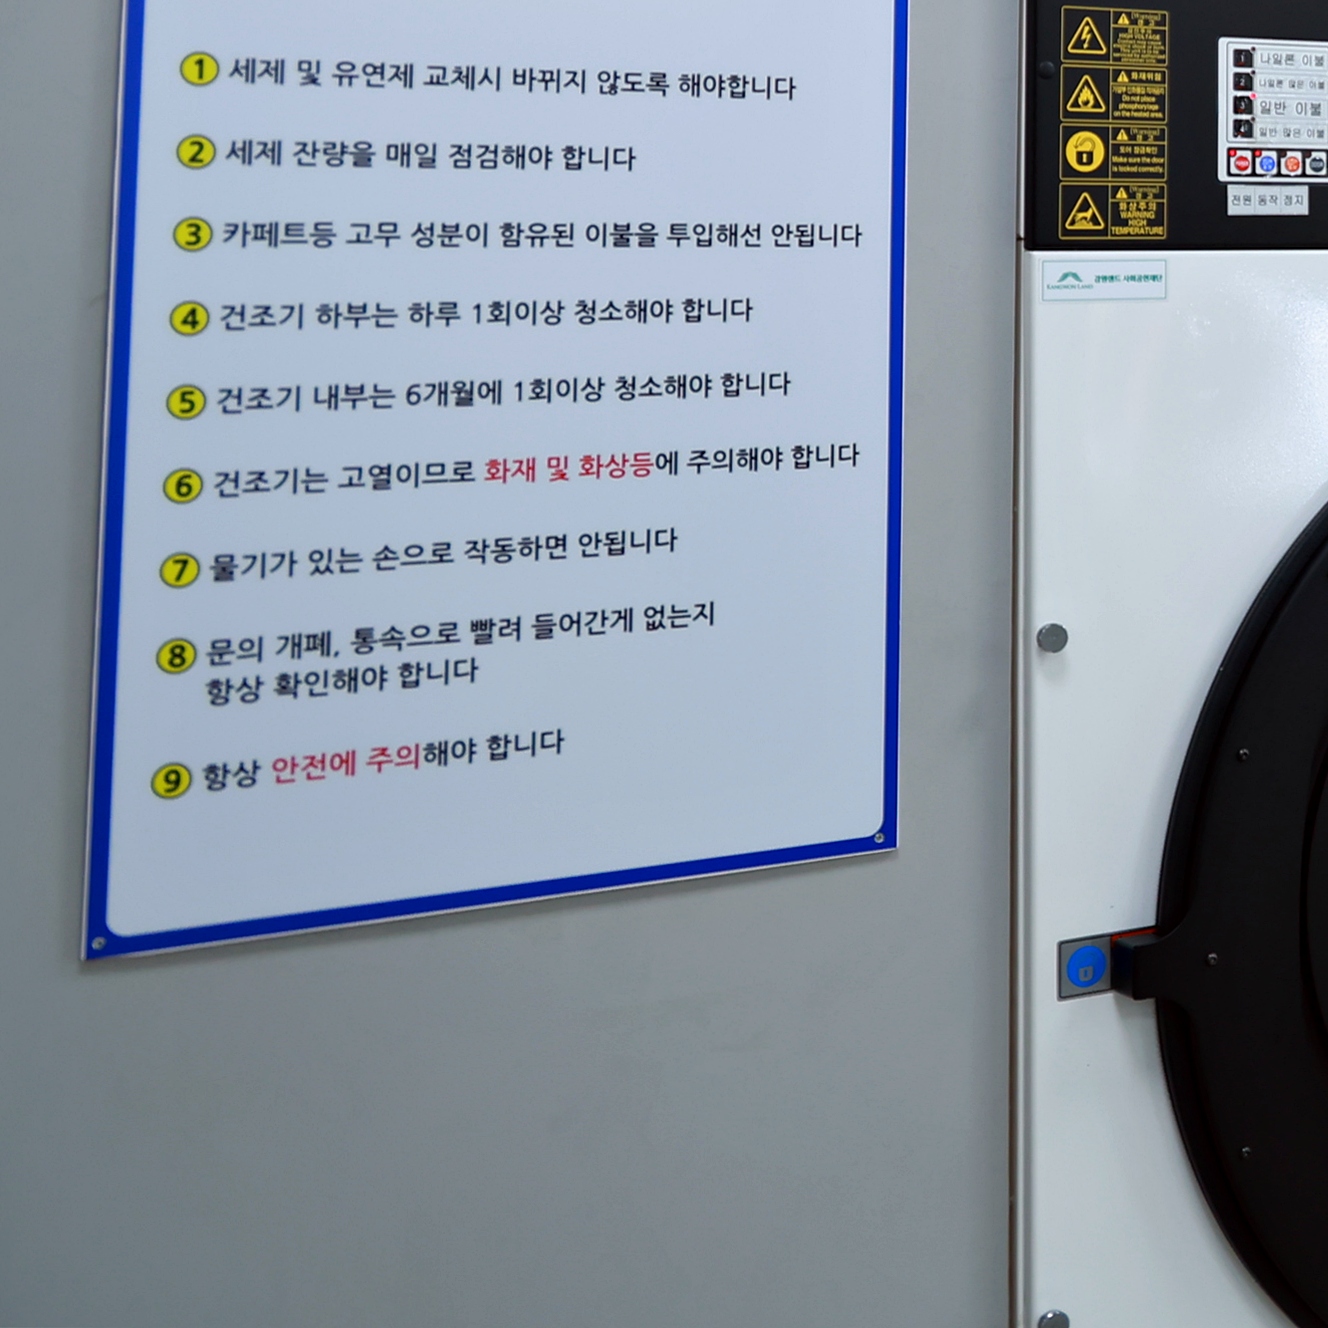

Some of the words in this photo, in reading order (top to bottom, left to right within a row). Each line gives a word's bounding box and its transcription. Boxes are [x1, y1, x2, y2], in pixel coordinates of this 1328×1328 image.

[1260, 53, 1295, 66] 나일론
[1302, 54, 1324, 66] 이불
[229, 57, 286, 86] 세제
[297, 59, 322, 87] 및
[331, 60, 414, 90] 유연제
[422, 65, 501, 92] 교체시
[512, 67, 586, 95] 바뀌지
[597, 70, 670, 97] 않도록
[678, 73, 797, 101] 해야합니다
[1260, 100, 1286, 115] 일반
[1295, 102, 1322, 116] 이불
[225, 139, 283, 167] 세제
[293, 140, 377, 168] 잔량을
[385, 142, 437, 169] 매일
[449, 143, 553, 171] 점검해야
[561, 145, 637, 172] 합니다
[1120, 211, 1155, 219] WARNING
[1230, 195, 1252, 207] 전원
[1257, 195, 1278, 206] 동작
[1282, 195, 1305, 207] 정지
[223, 221, 337, 249] 카페트등
[345, 221, 401, 248] 고무
[410, 222, 489, 249] 성분이
[499, 222, 575, 248] 함유된
[585, 222, 659, 248] 이불을
[666, 222, 761, 248] 투입해선
[771, 223, 863, 248] 안됩니다
[1111, 227, 1163, 235] TEMPERATURE
[220, 303, 304, 332] 건조기
[315, 302, 399, 330] 하부는
[407, 301, 461, 328] 하루
[473, 299, 566, 327] 1회이상
[574, 298, 674, 326] 청소해야
[681, 297, 754, 324] 합니다
[217, 385, 301, 415] 건조기
[313, 383, 396, 411] 내부는
[405, 379, 503, 408] 6개월에
[514, 376, 606, 404] 1회이상
[614, 373, 713, 402] 청소해야
[720, 371, 792, 398] 합니다
[214, 467, 329, 499] 건조기는
[337, 460, 476, 491] 고열이므로
[484, 457, 536, 484] 화재
[547, 455, 569, 482] 및
[578, 450, 679, 480] 화상등에
[686, 446, 784, 475] 주의해야
[790, 442, 860, 470] 합니다
[209, 550, 298, 583] 물기가
[308, 547, 364, 576] 있는
[371, 541, 455, 572] 손으로
[464, 533, 567, 565] 작동하면
[578, 527, 679, 558] 안됩니다
[205, 635, 264, 667] 문의
[275, 630, 340, 660] 개폐,
[350, 621, 461, 656] 통속으로
[470, 615, 522, 646] 빨려
[531, 607, 634, 641] 들어간게
[643, 600, 715, 632] 없는지
[205, 674, 265, 707] 항상
[273, 664, 389, 700] 확인해야
[398, 656, 479, 690] 합니다
[202, 759, 262, 792] 항상
[271, 749, 357, 785] 안전에
[365, 737, 478, 774] 주의해야
[486, 728, 565, 762] 합니다
